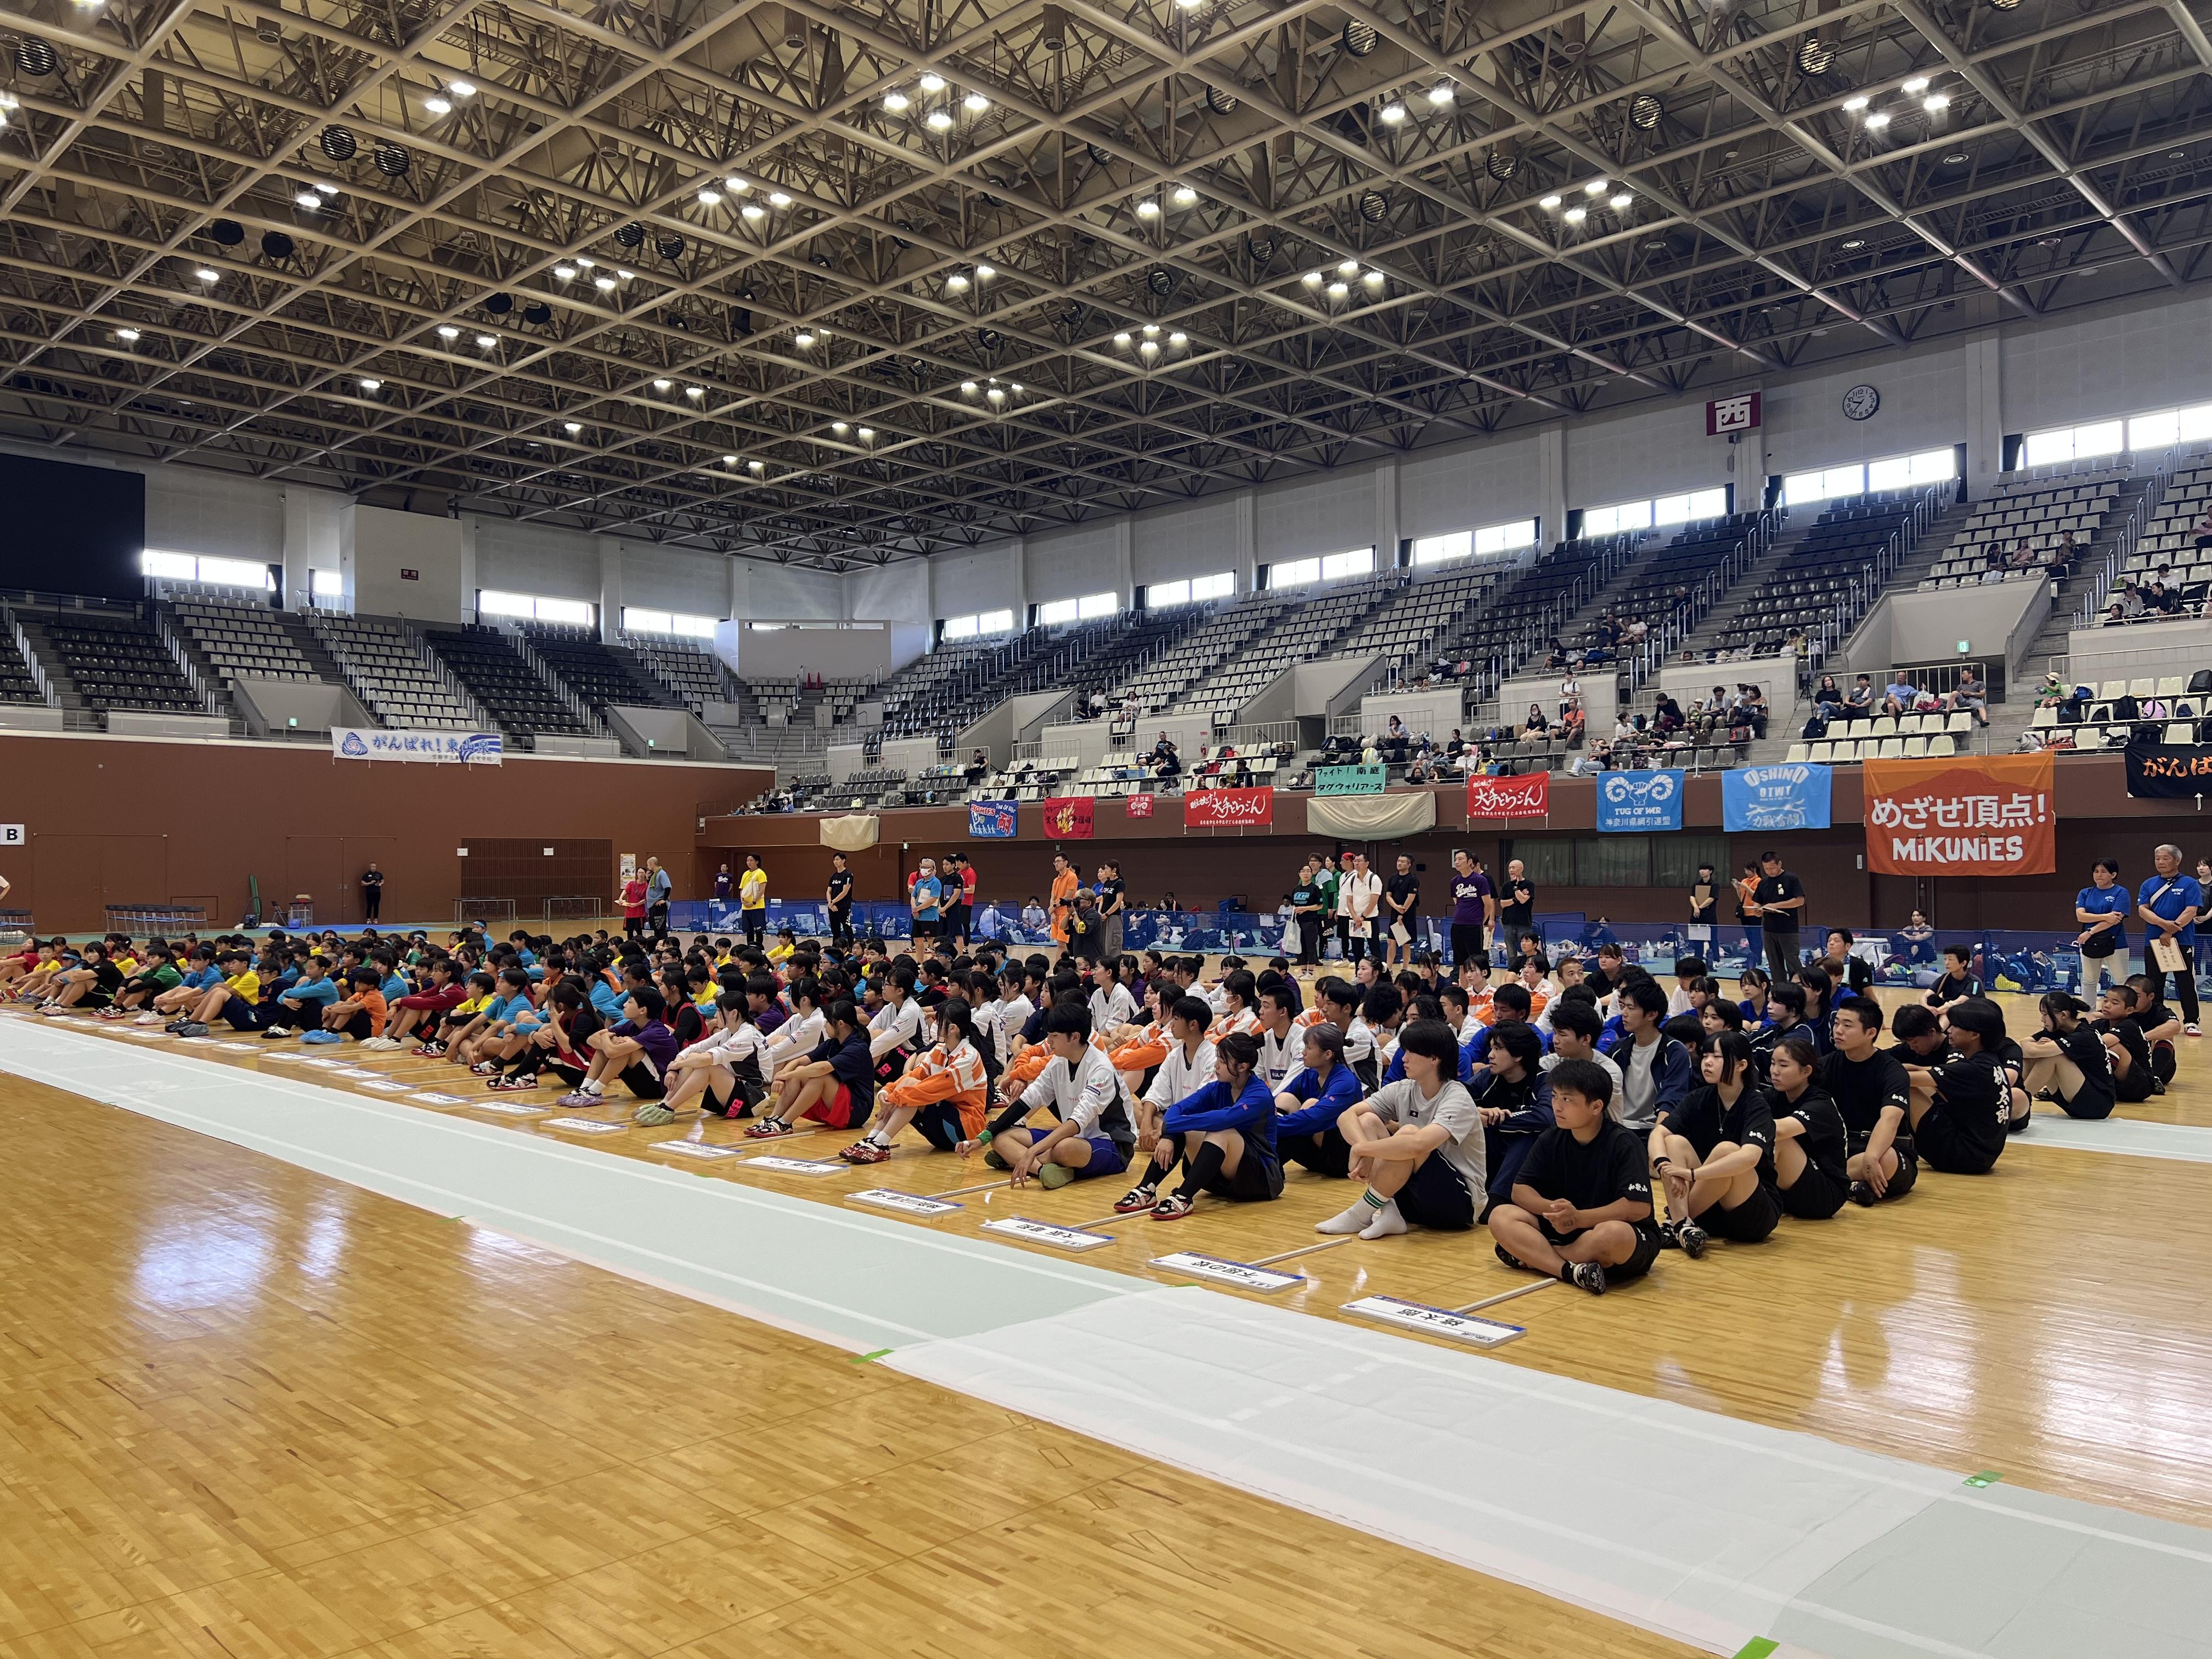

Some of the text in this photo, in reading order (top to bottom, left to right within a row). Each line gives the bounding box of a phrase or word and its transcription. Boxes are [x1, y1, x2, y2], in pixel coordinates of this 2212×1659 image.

[1715, 395, 1751, 432] 西
[1871, 793, 2045, 828] めざせ頂点!
[7, 829, 18, 840] B
[1397, 1309, 1465, 1327] 桃太郎
